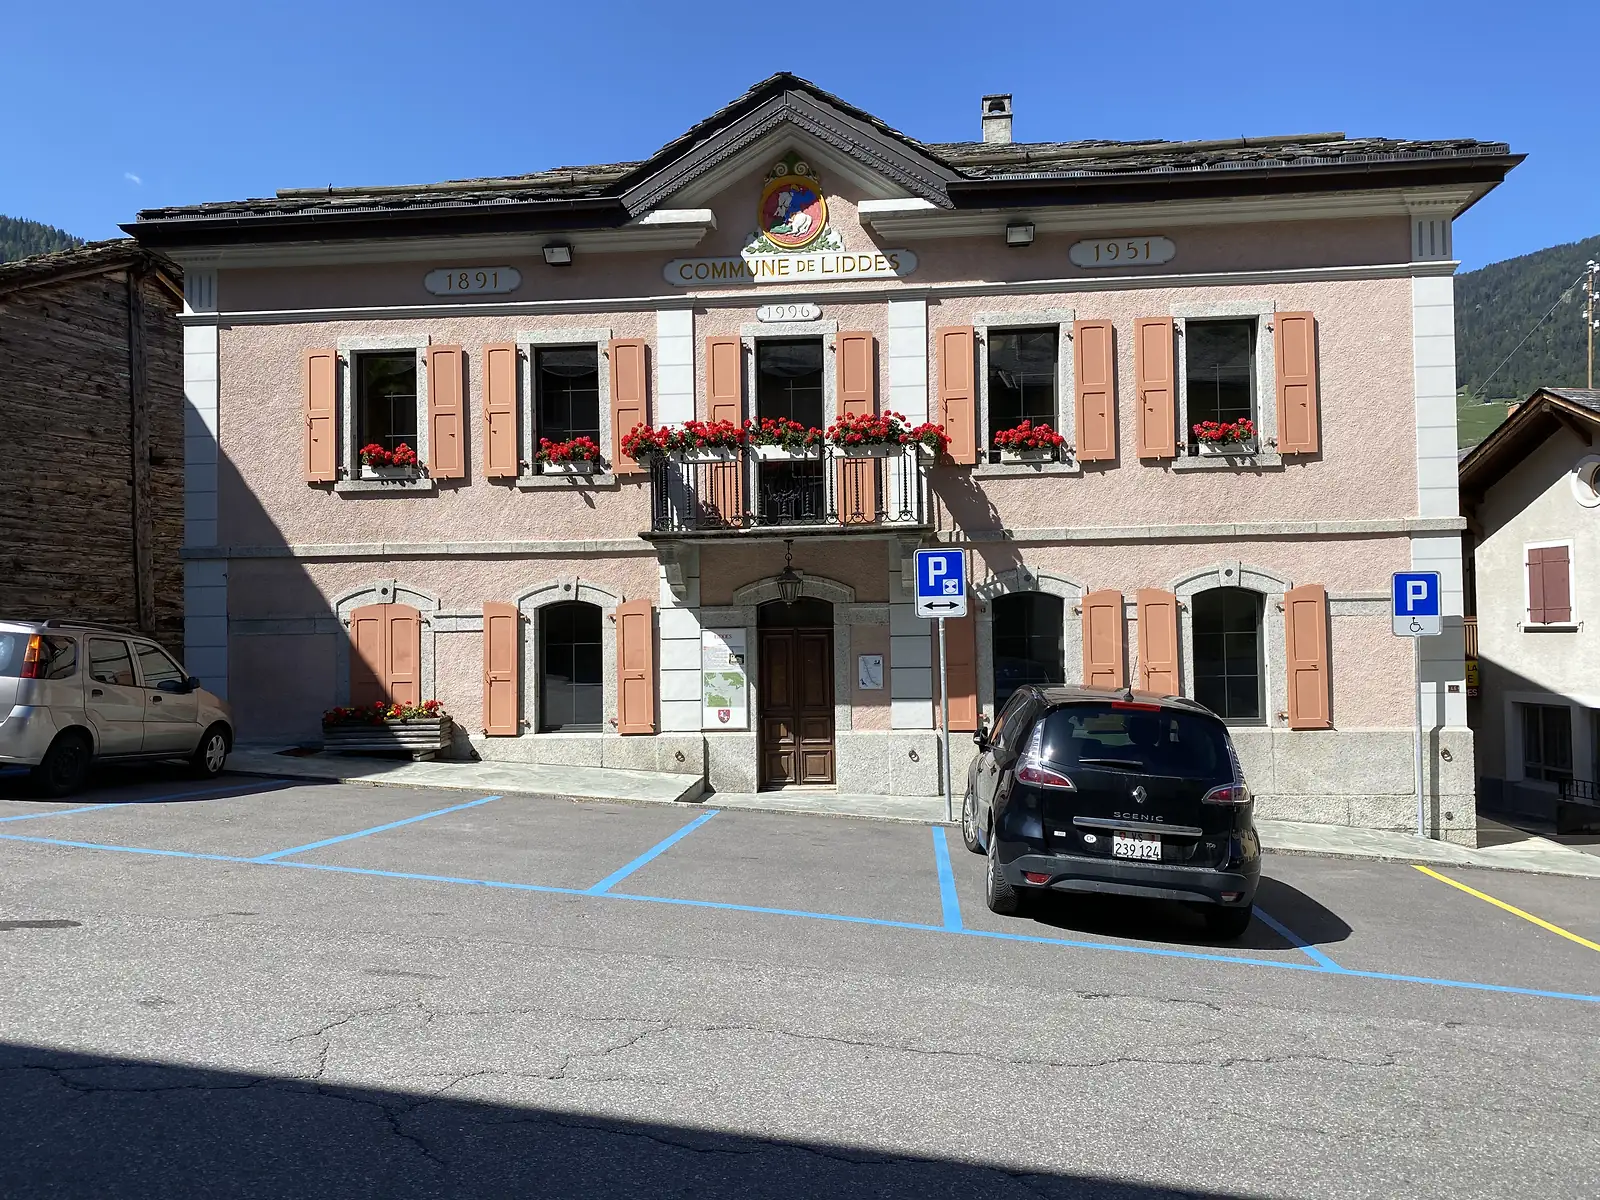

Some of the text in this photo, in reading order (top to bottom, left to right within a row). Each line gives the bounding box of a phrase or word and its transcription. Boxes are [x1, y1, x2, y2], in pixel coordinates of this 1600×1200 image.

[1094, 241, 1150, 262] 1951
[679, 253, 900, 281] COMMUNE DE LIDDES
[446, 272, 498, 290] 1891
[767, 305, 810, 319] 1996
[928, 556, 947, 587] P
[1406, 580, 1428, 611] P
[1113, 811, 1164, 822] SCENIC
[1131, 832, 1143, 843] VS
[1115, 842, 1160, 860] 239 124
